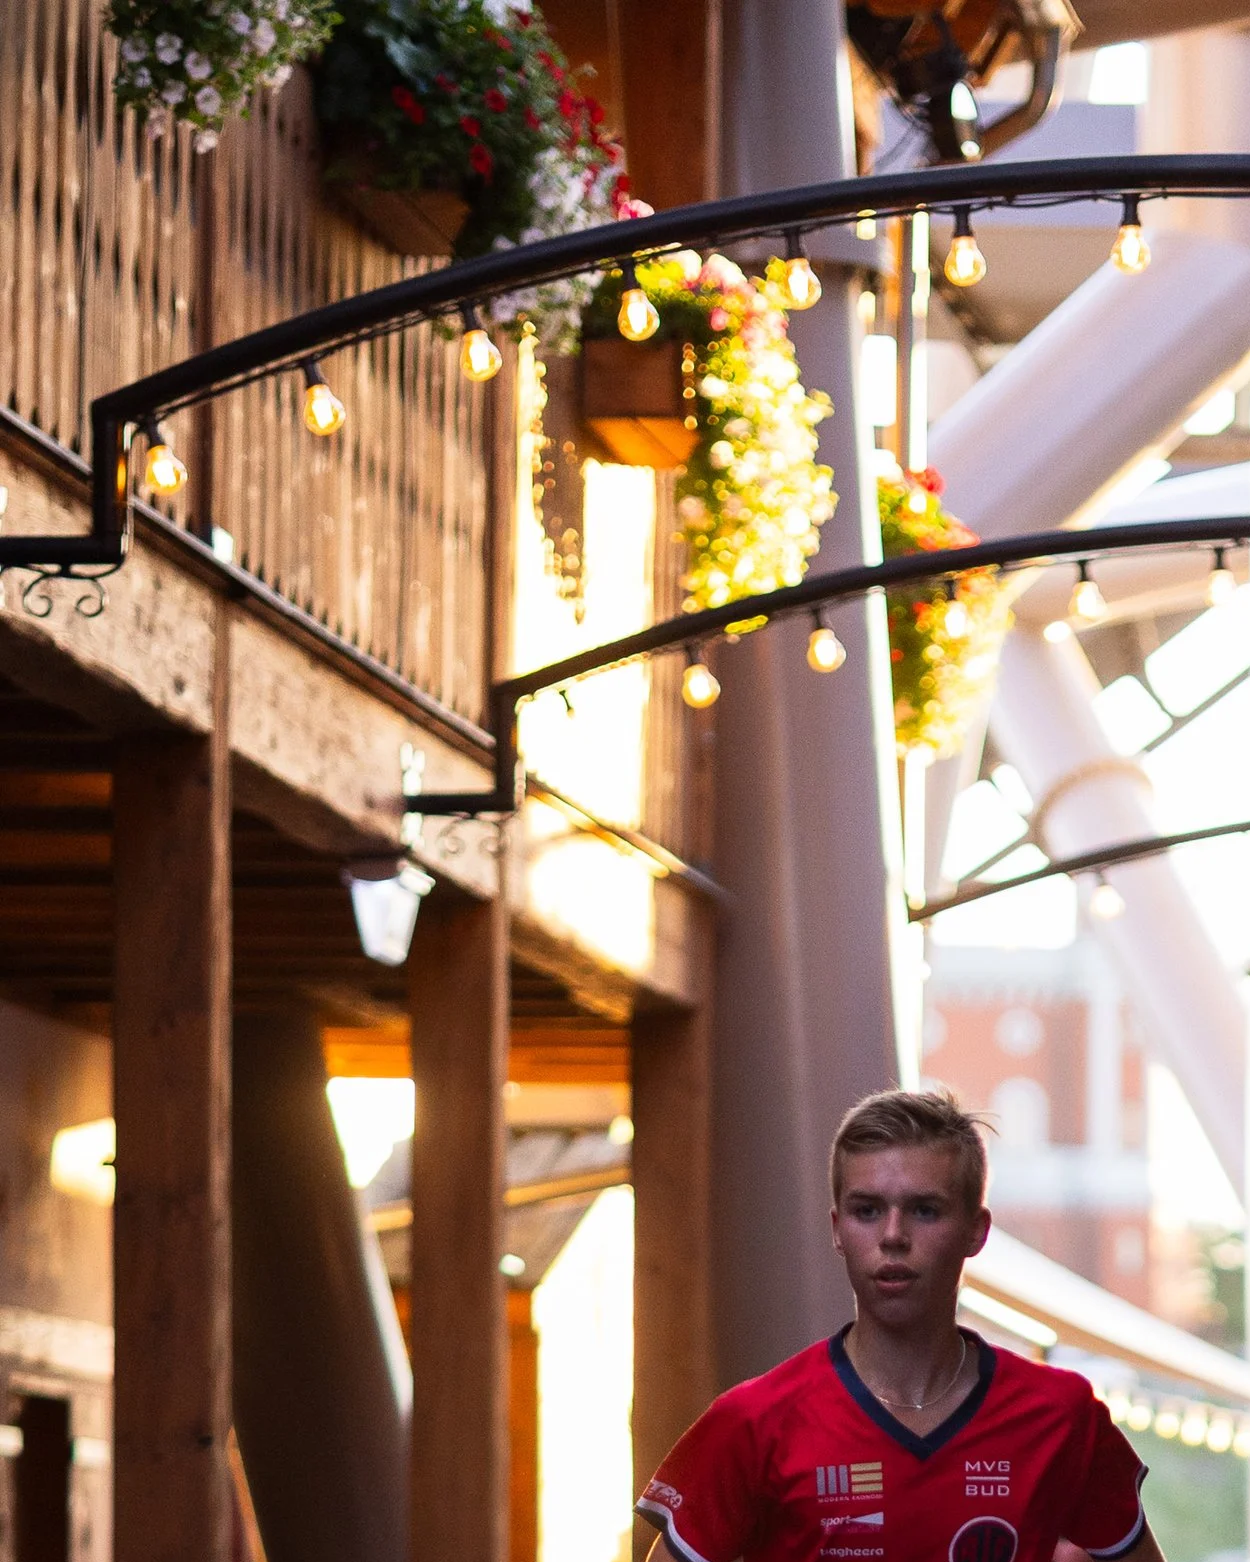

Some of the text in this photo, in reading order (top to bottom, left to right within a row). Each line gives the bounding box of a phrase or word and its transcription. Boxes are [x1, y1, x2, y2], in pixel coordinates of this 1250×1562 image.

[965, 1461, 1011, 1472] MVG
[965, 1484, 1010, 1496] BUD
[820, 1515, 851, 1528] sport
